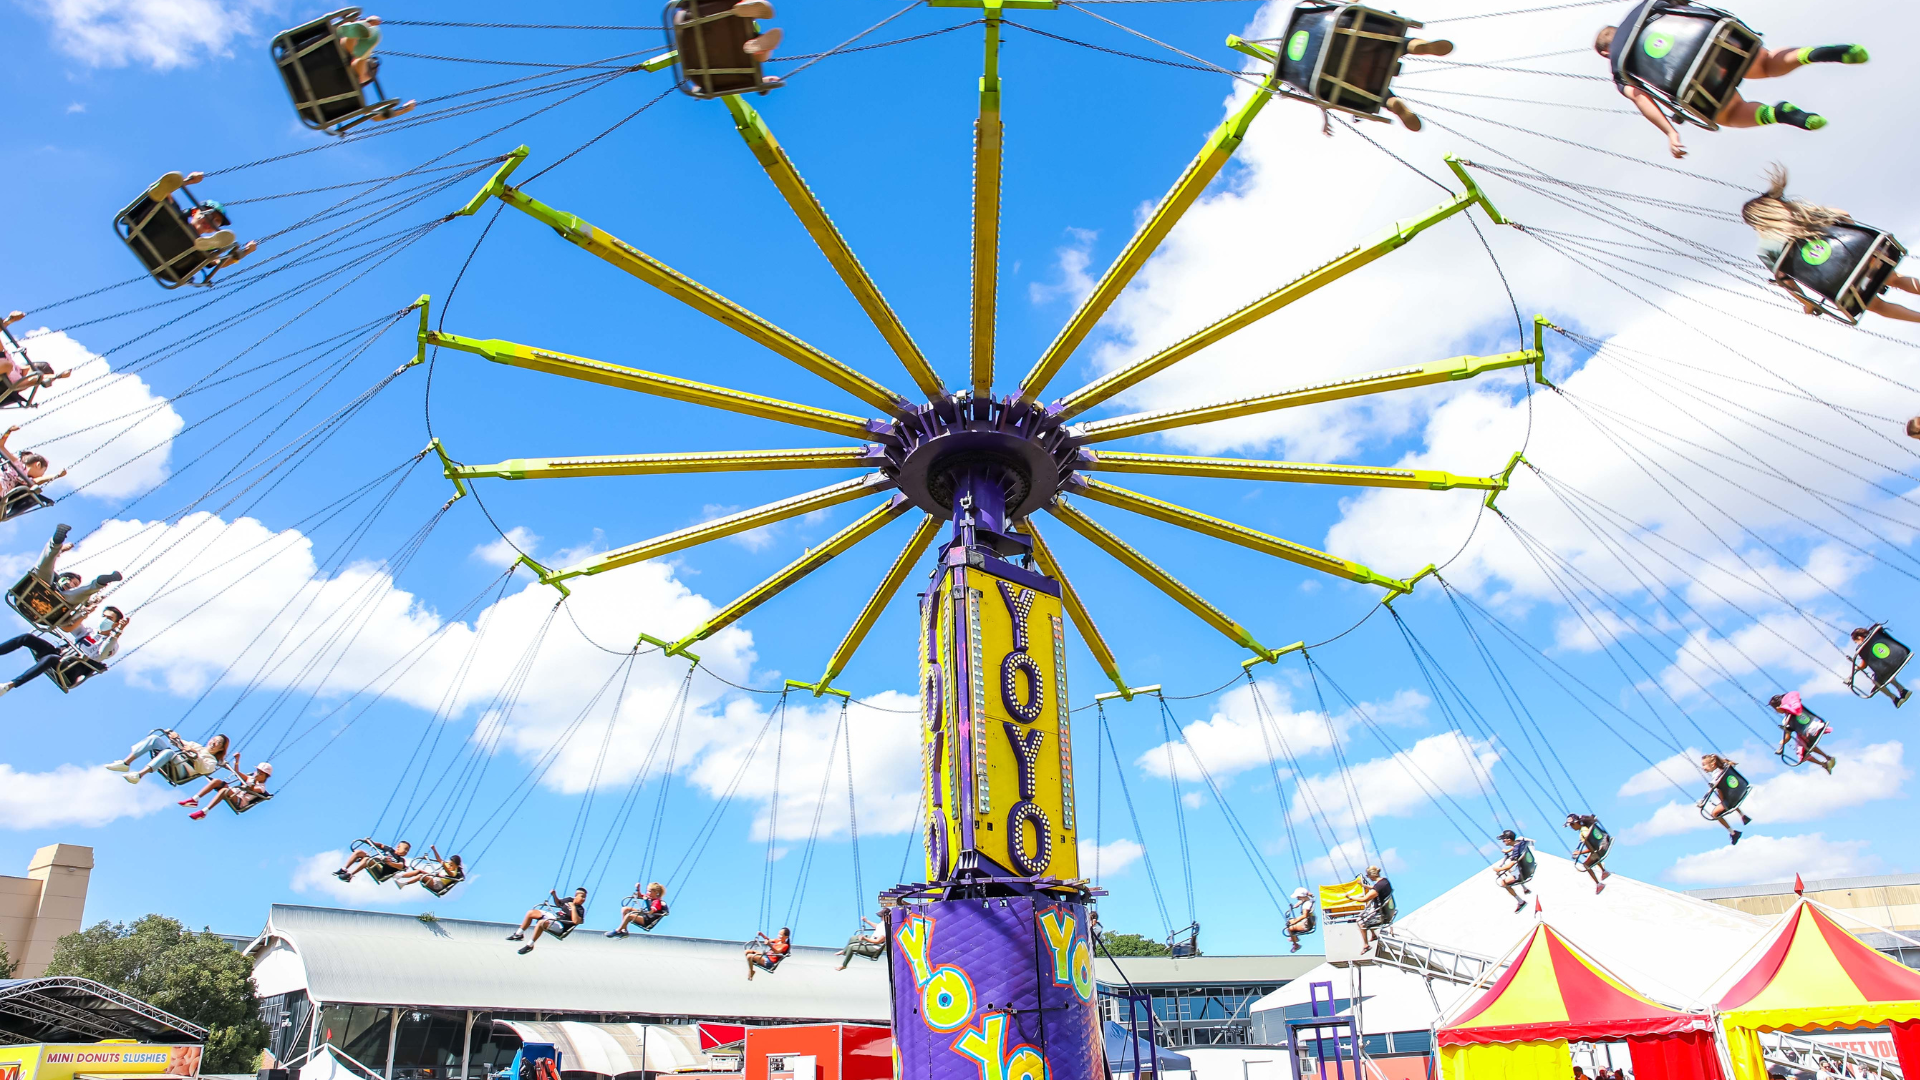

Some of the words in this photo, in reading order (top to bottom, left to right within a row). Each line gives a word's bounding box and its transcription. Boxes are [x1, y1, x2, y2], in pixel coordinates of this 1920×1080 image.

[996, 580, 1052, 877] YOYO
[46, 1053, 74, 1063] MINI
[76, 1053, 120, 1063] DONUTS
[122, 1053, 167, 1063] SLUSHIES
